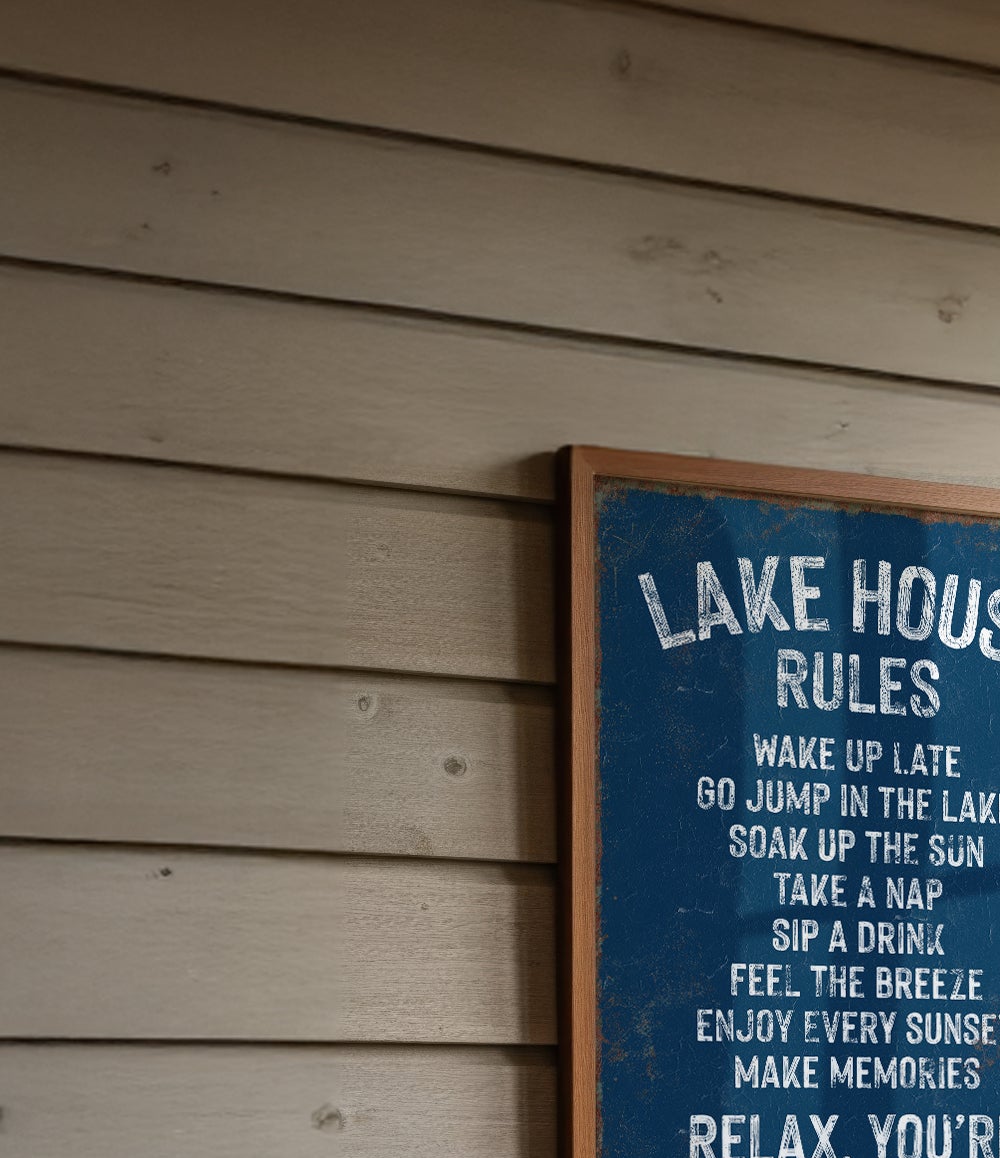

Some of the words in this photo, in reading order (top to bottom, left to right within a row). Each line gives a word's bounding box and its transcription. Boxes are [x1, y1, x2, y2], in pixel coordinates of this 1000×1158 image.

[638, 556, 829, 650] LAKE
[777, 649, 940, 717] RULES
[753, 734, 835, 770] WAKE
[847, 740, 882, 772] UP
[894, 743, 960, 777] LATE
[698, 777, 735, 810] GO
[746, 780, 830, 815] JUMP
[841, 784, 867, 817] IN
[878, 787, 931, 820] THE
[730, 825, 808, 860] SOAK
[819, 829, 855, 862] UP
[865, 831, 918, 864] THE
[929, 834, 983, 867] SUN
[774, 873, 846, 907] TAKE
[857, 876, 875, 907] A
[887, 877, 942, 910] NAP
[773, 919, 818, 951] SIP
[829, 921, 847, 952] A
[859, 921, 944, 955] DRINK
[731, 964, 800, 997] FEEL
[810, 965, 864, 998] THE
[877, 967, 983, 1000] BREEZE
[697, 1009, 793, 1042] ENJOY
[805, 1011, 896, 1043] EVERY
[735, 1056, 818, 1088] MAKE
[831, 1057, 980, 1089] MEMORIES
